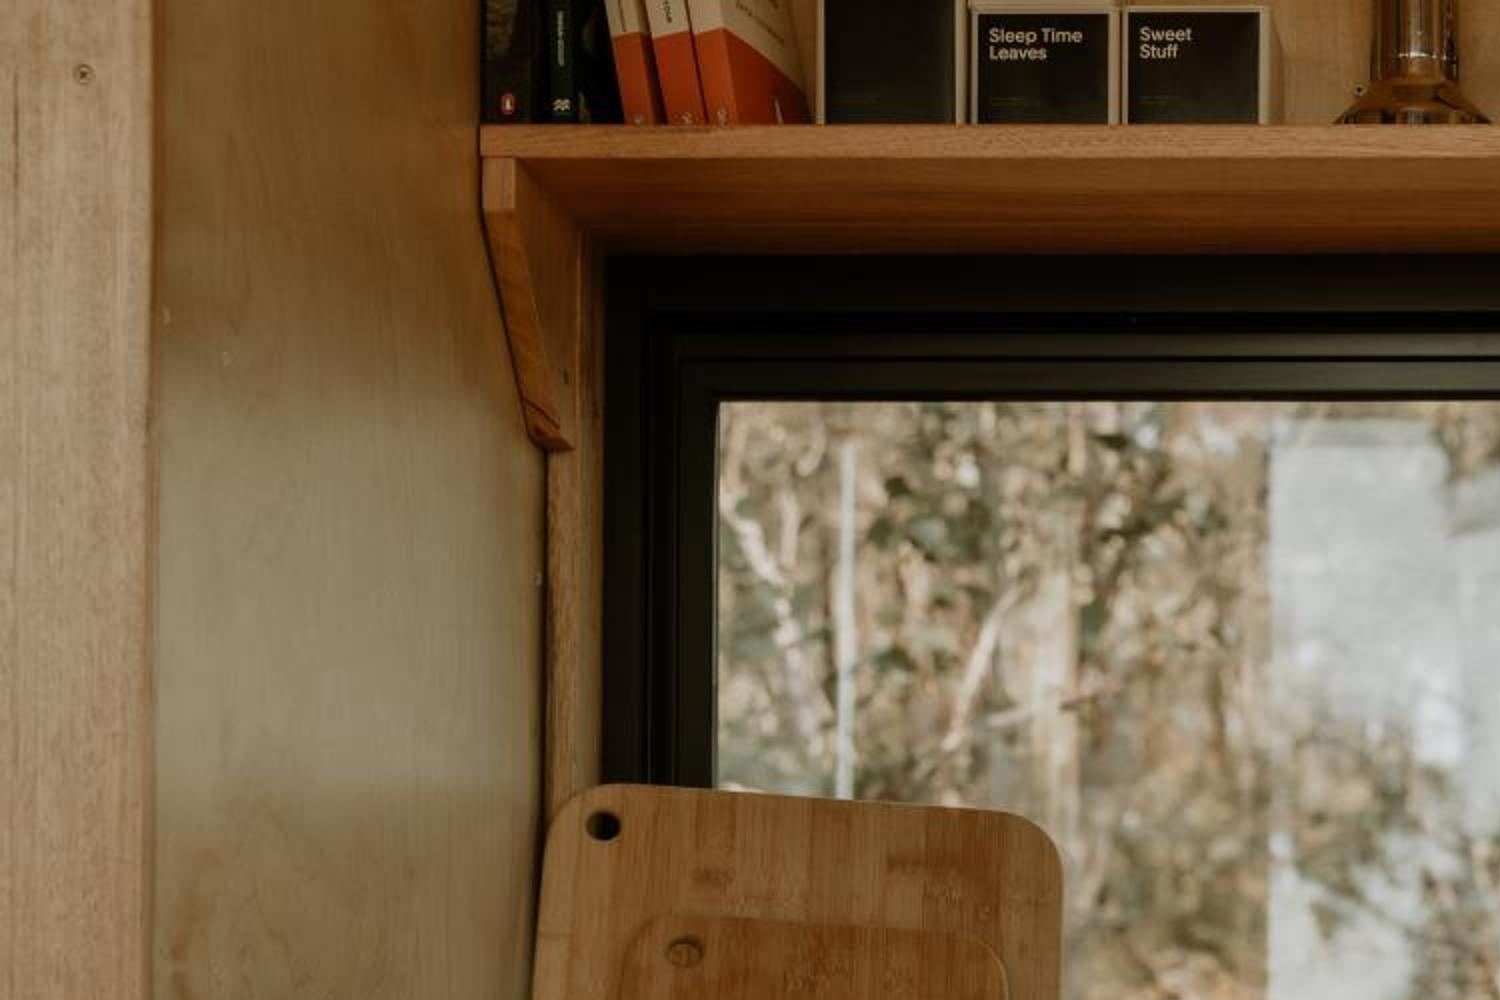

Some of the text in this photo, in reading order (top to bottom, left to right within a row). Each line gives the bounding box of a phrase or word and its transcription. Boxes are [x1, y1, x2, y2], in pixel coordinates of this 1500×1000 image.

[988, 28, 1083, 45] Sleep Time
[1139, 26, 1193, 41] Sweet
[988, 46, 1048, 61] Leaves
[1139, 43, 1180, 59] Stuff
